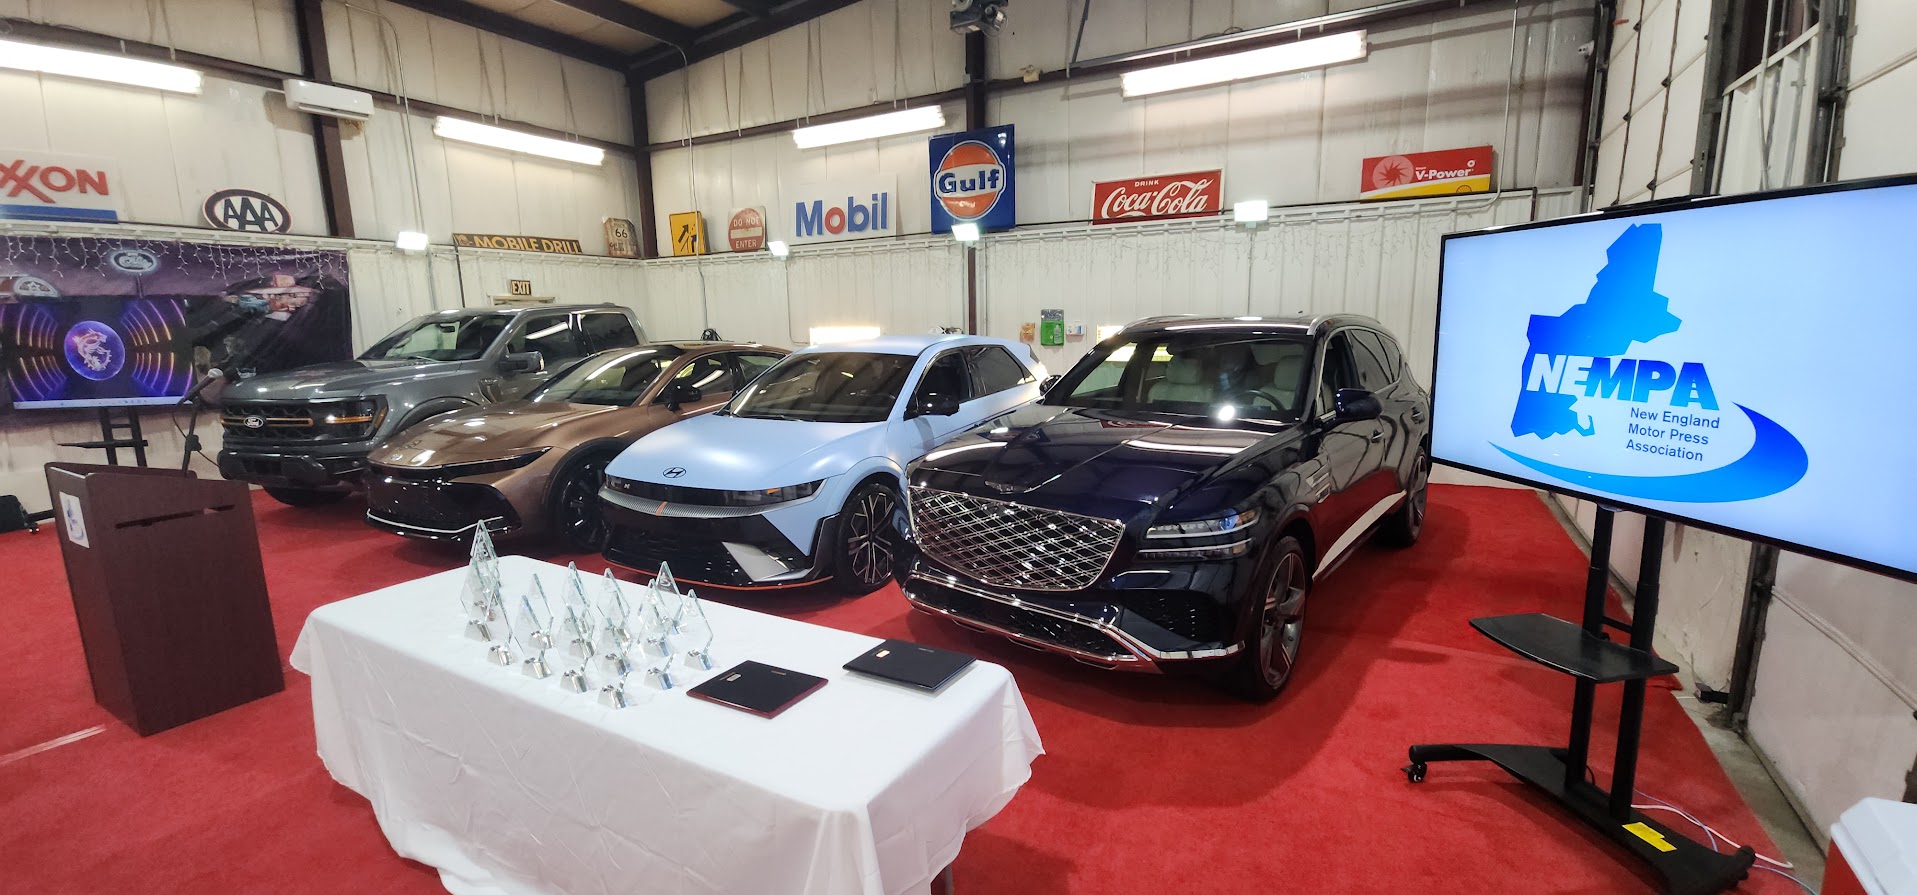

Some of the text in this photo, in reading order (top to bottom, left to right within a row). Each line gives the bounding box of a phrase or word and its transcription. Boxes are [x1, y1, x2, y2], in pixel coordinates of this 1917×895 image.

[939, 169, 999, 193] Gulf
[1134, 179, 1159, 187] DRINK
[1415, 169, 1471, 180] V-Power
[1101, 179, 1214, 219] Coca-Cola
[223, 197, 279, 232] AAA
[733, 216, 760, 227] DO NOT
[796, 192, 888, 237] Mobil
[473, 235, 582, 254] MOBILE DRILL
[615, 228, 628, 239] 66
[735, 239, 757, 249] ENTER
[511, 280, 531, 295] EXIT
[1526, 353, 1720, 411] NEMPA
[1630, 407, 1720, 429] New England
[1628, 423, 1709, 445] Motor Press
[1626, 439, 1703, 461] Association
